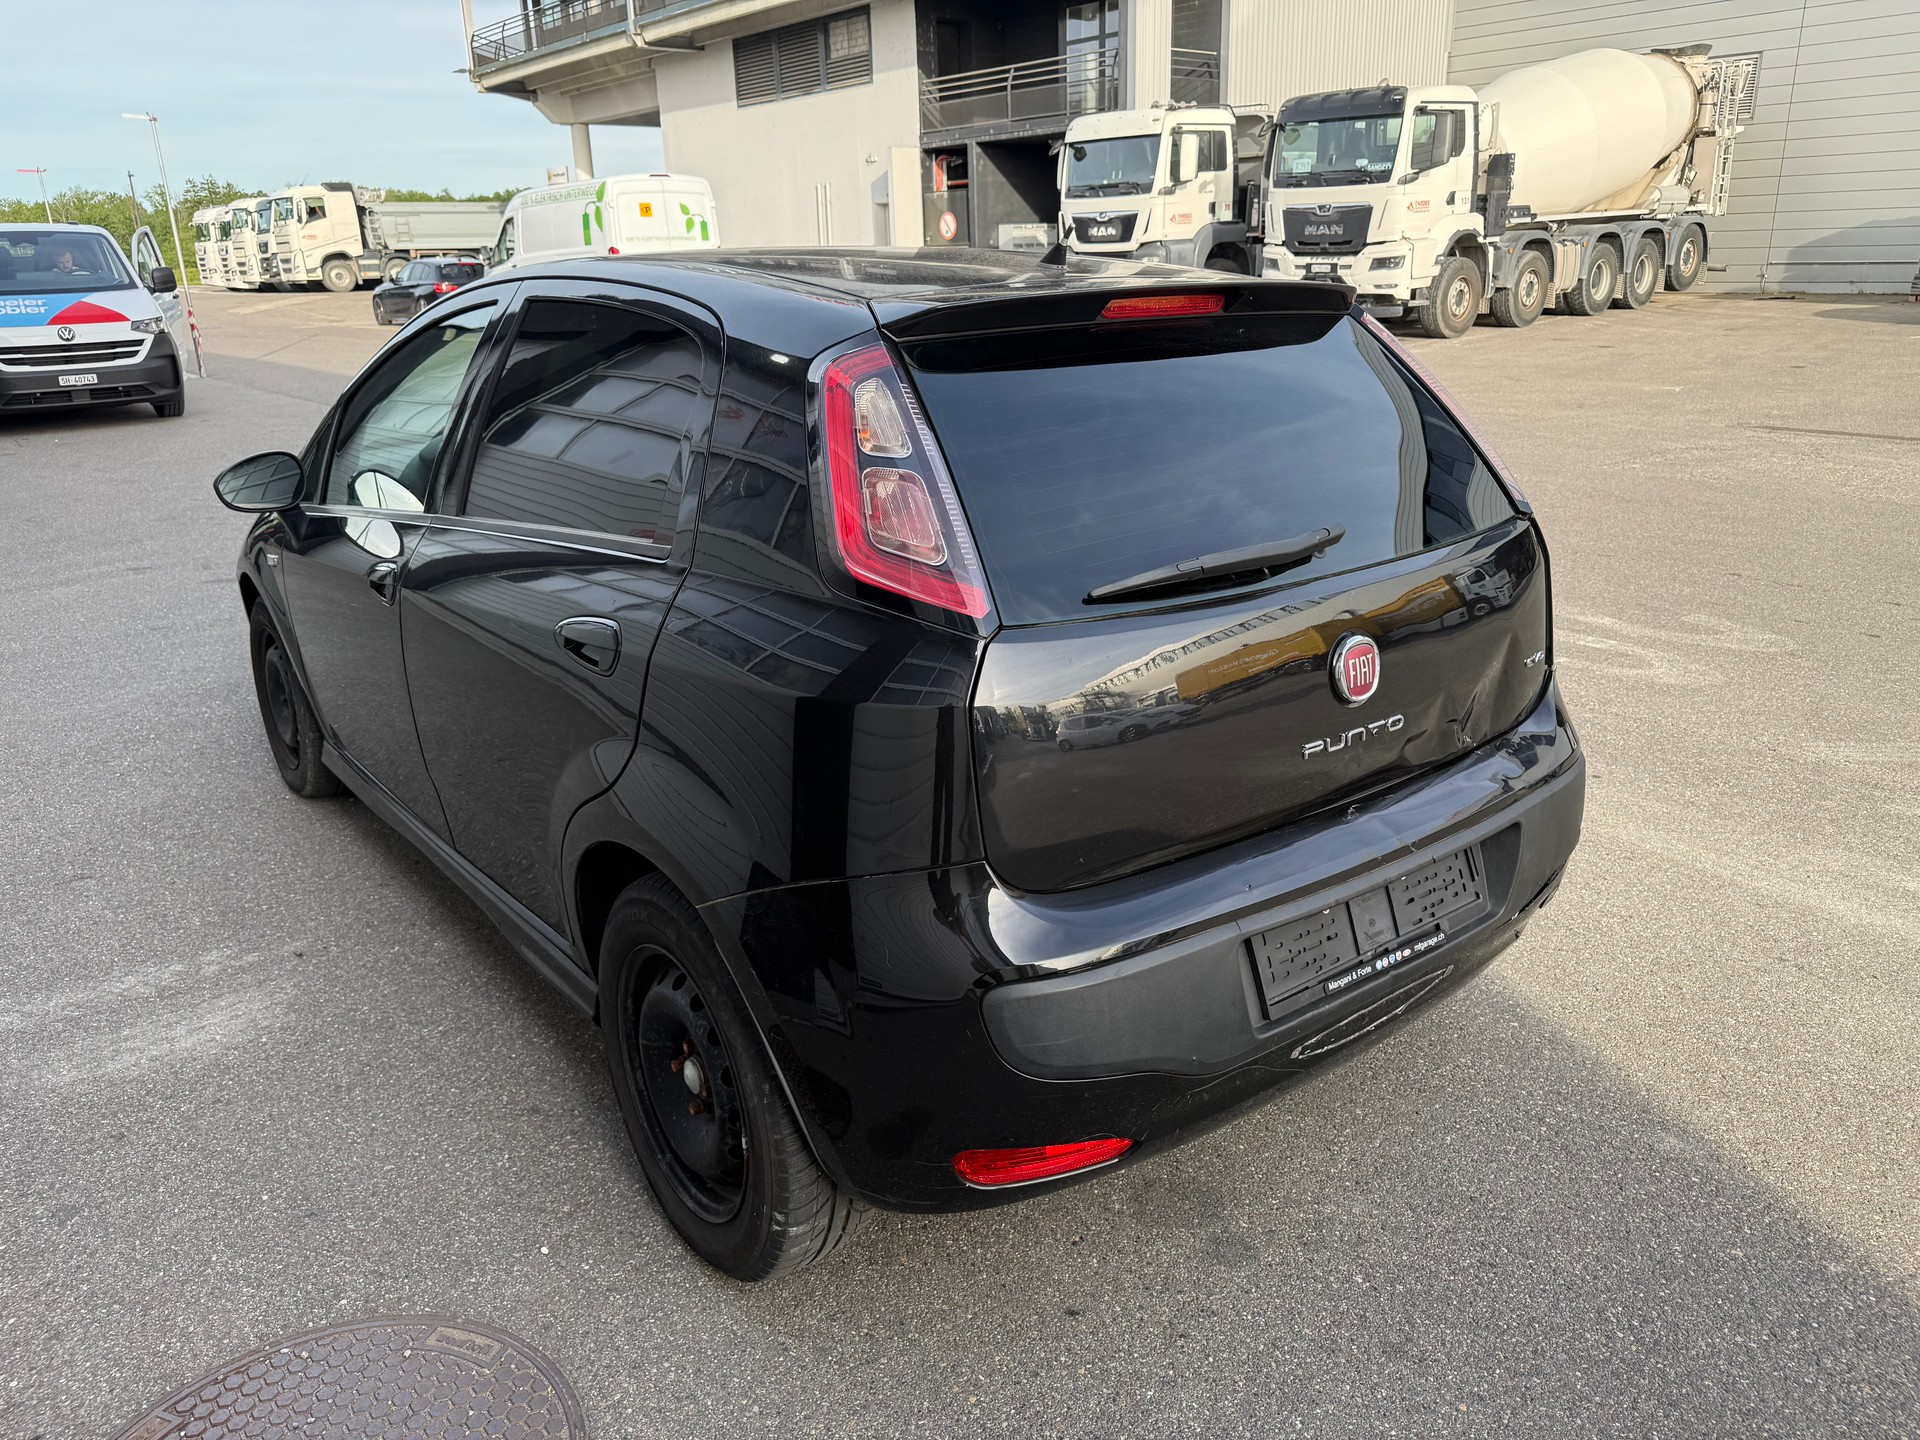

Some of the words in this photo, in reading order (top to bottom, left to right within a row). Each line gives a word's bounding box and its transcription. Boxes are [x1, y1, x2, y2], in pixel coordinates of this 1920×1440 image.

[535, 190, 563, 204] ELEKTRISCH
[564, 185, 597, 200] UNTERWEGS
[1087, 226, 1117, 237] MAN
[1304, 223, 1344, 236] MAN
[1348, 653, 1373, 689] FIAT
[1302, 713, 1405, 761] PUNTO
[1328, 974, 1352, 991] Mangani
[1357, 965, 1372, 978] Forte
[1413, 932, 1445, 952] mfgarage.ch
